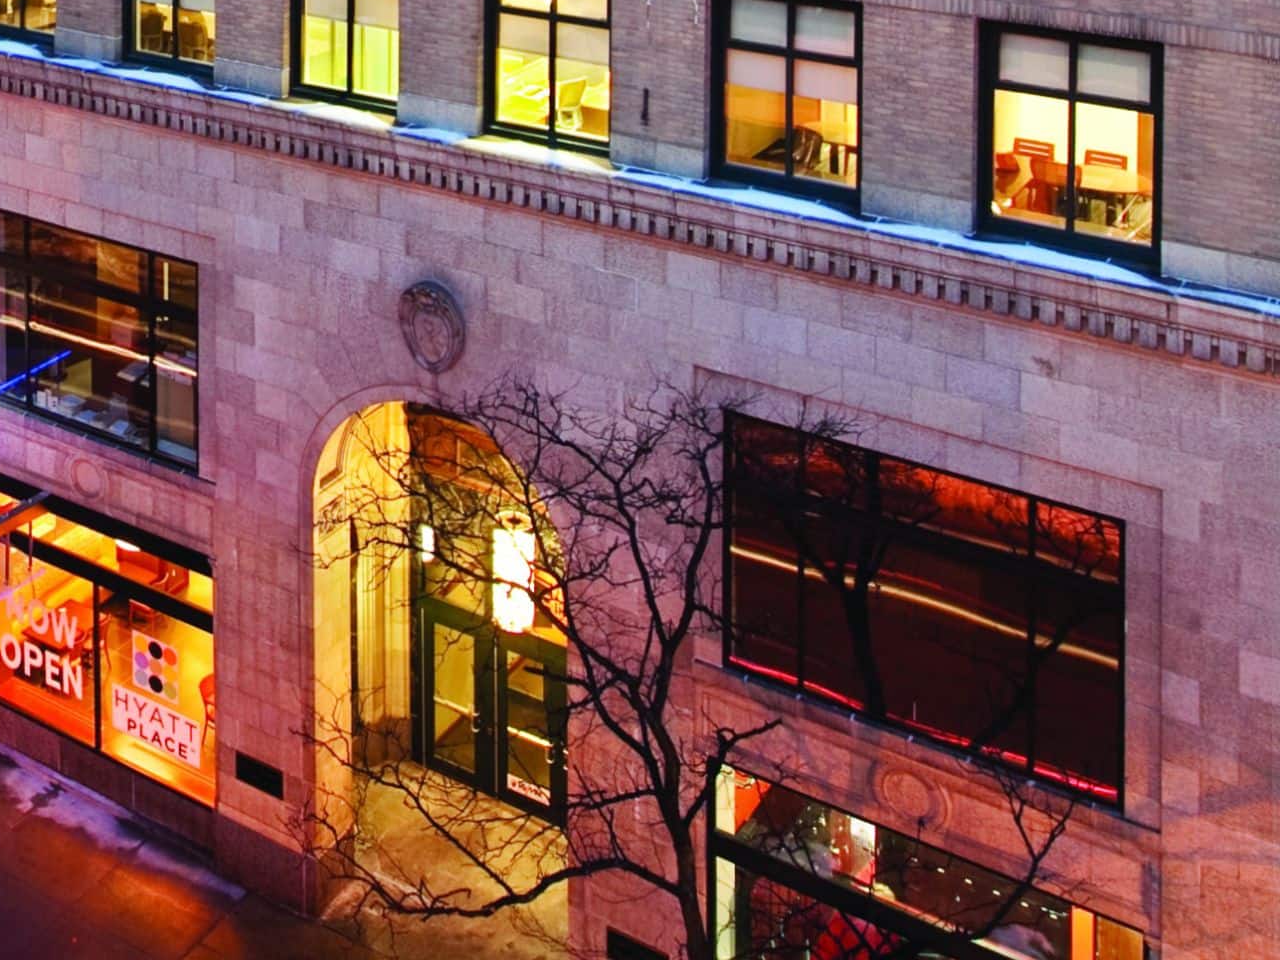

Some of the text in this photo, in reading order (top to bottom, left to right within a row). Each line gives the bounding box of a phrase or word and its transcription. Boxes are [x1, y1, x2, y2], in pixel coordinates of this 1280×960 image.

[5, 593, 78, 649] NOW
[0, 634, 83, 701] OPEN
[114, 689, 197, 743] HYATT
[127, 718, 188, 759] PLACE
